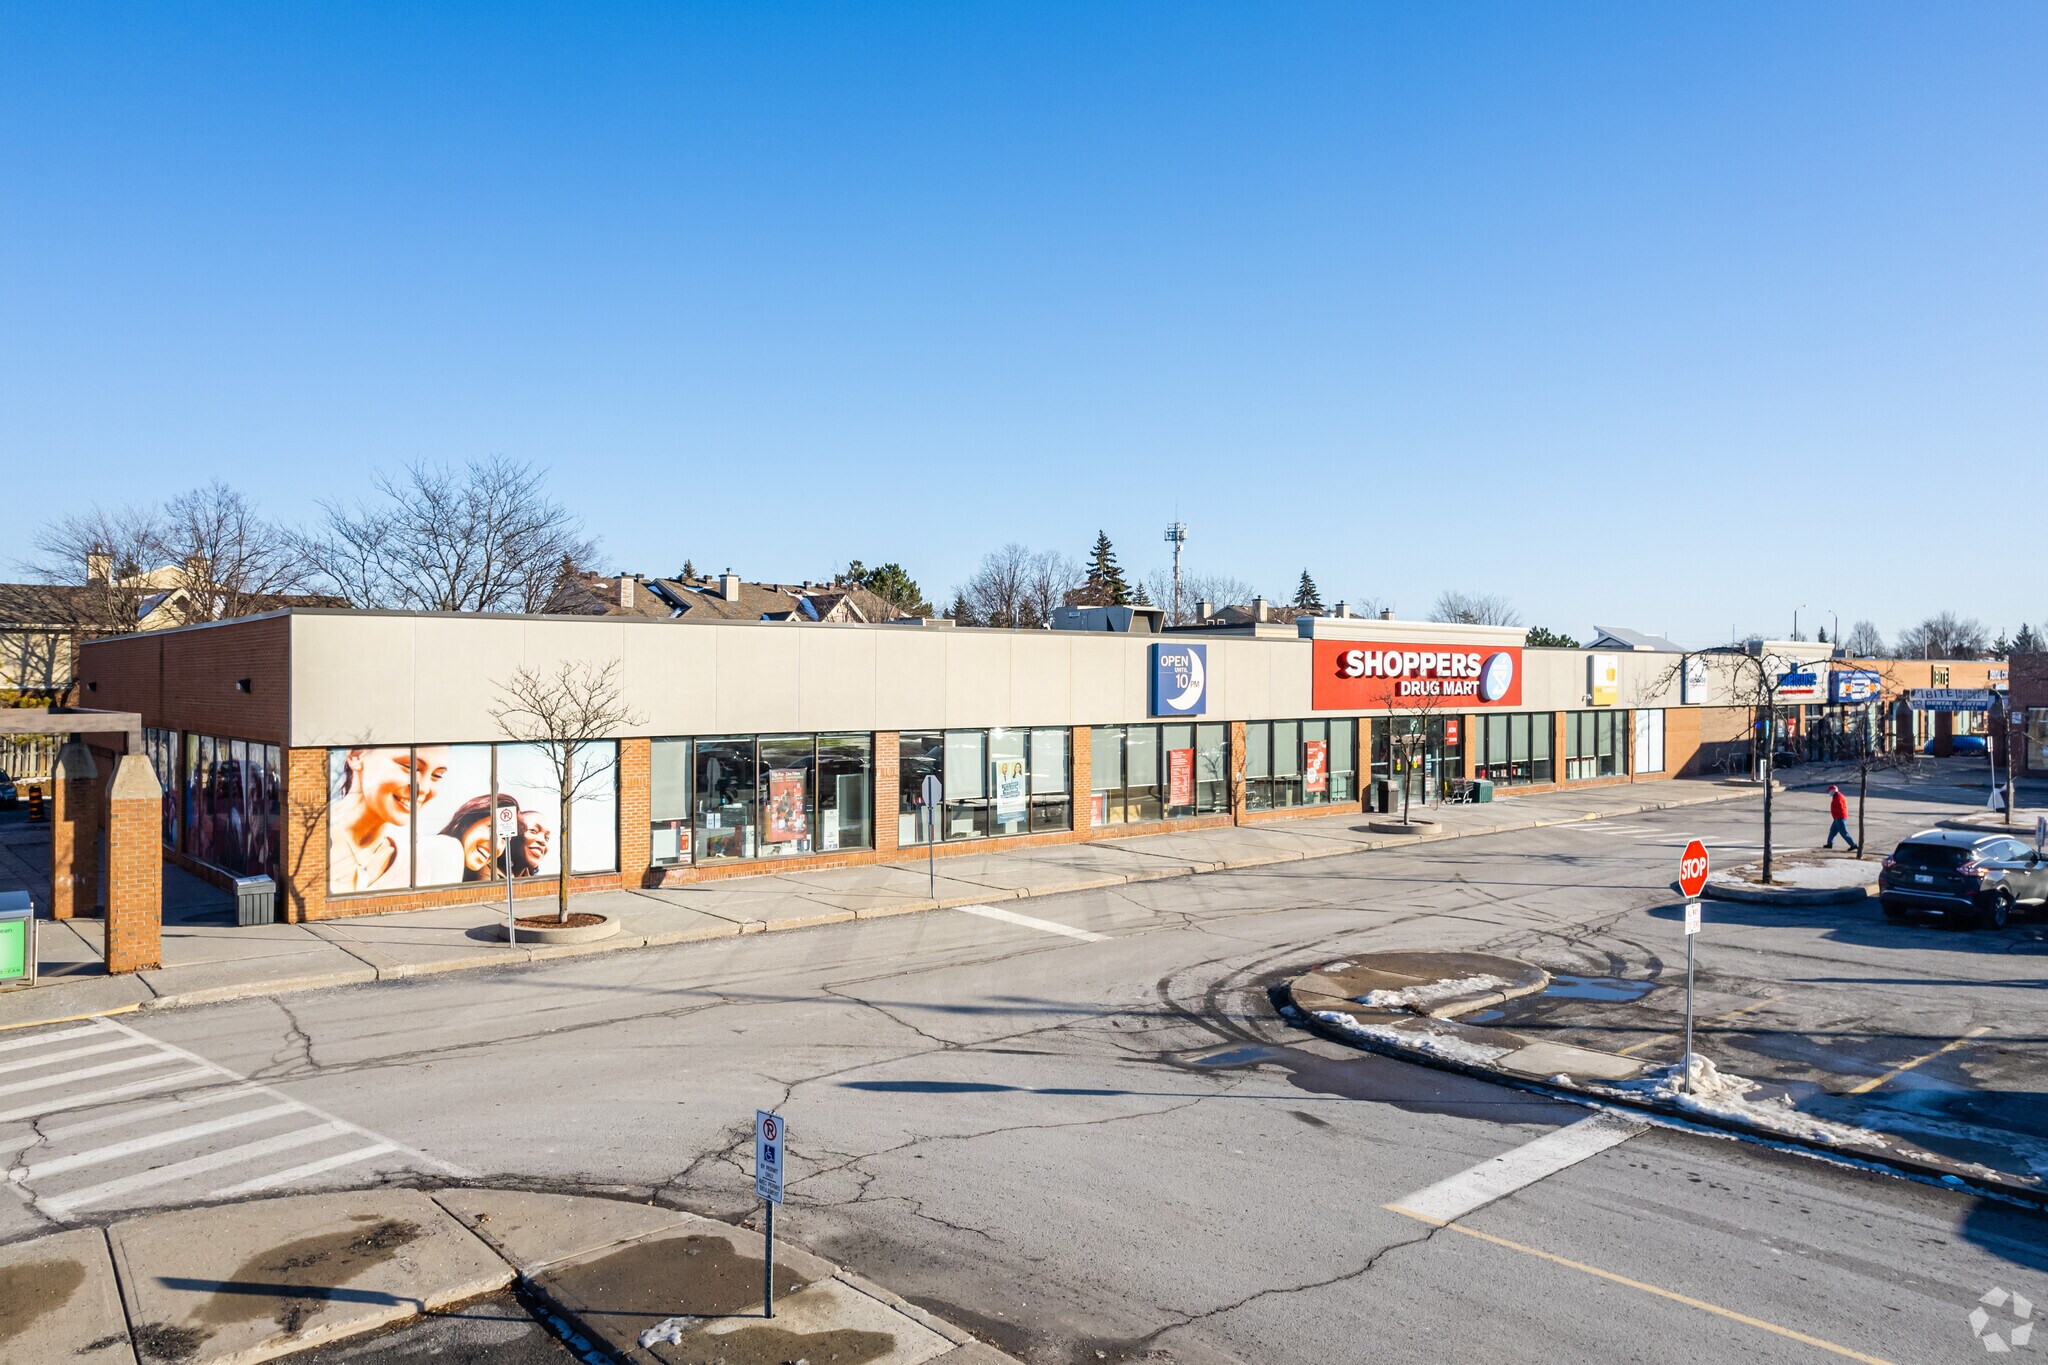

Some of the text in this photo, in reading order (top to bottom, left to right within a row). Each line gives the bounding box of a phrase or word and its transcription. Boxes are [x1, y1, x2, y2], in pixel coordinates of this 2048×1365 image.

[1160, 655, 1189, 667] OPEN
[1345, 650, 1482, 677] SHOPPERS
[1175, 673, 1200, 689] 10 PM
[1401, 680, 1480, 696] DRUG MART
[1925, 688, 1954, 699] BITE
[1681, 857, 1706, 880] STOP
[766, 1165, 778, 1174] PERMIT
